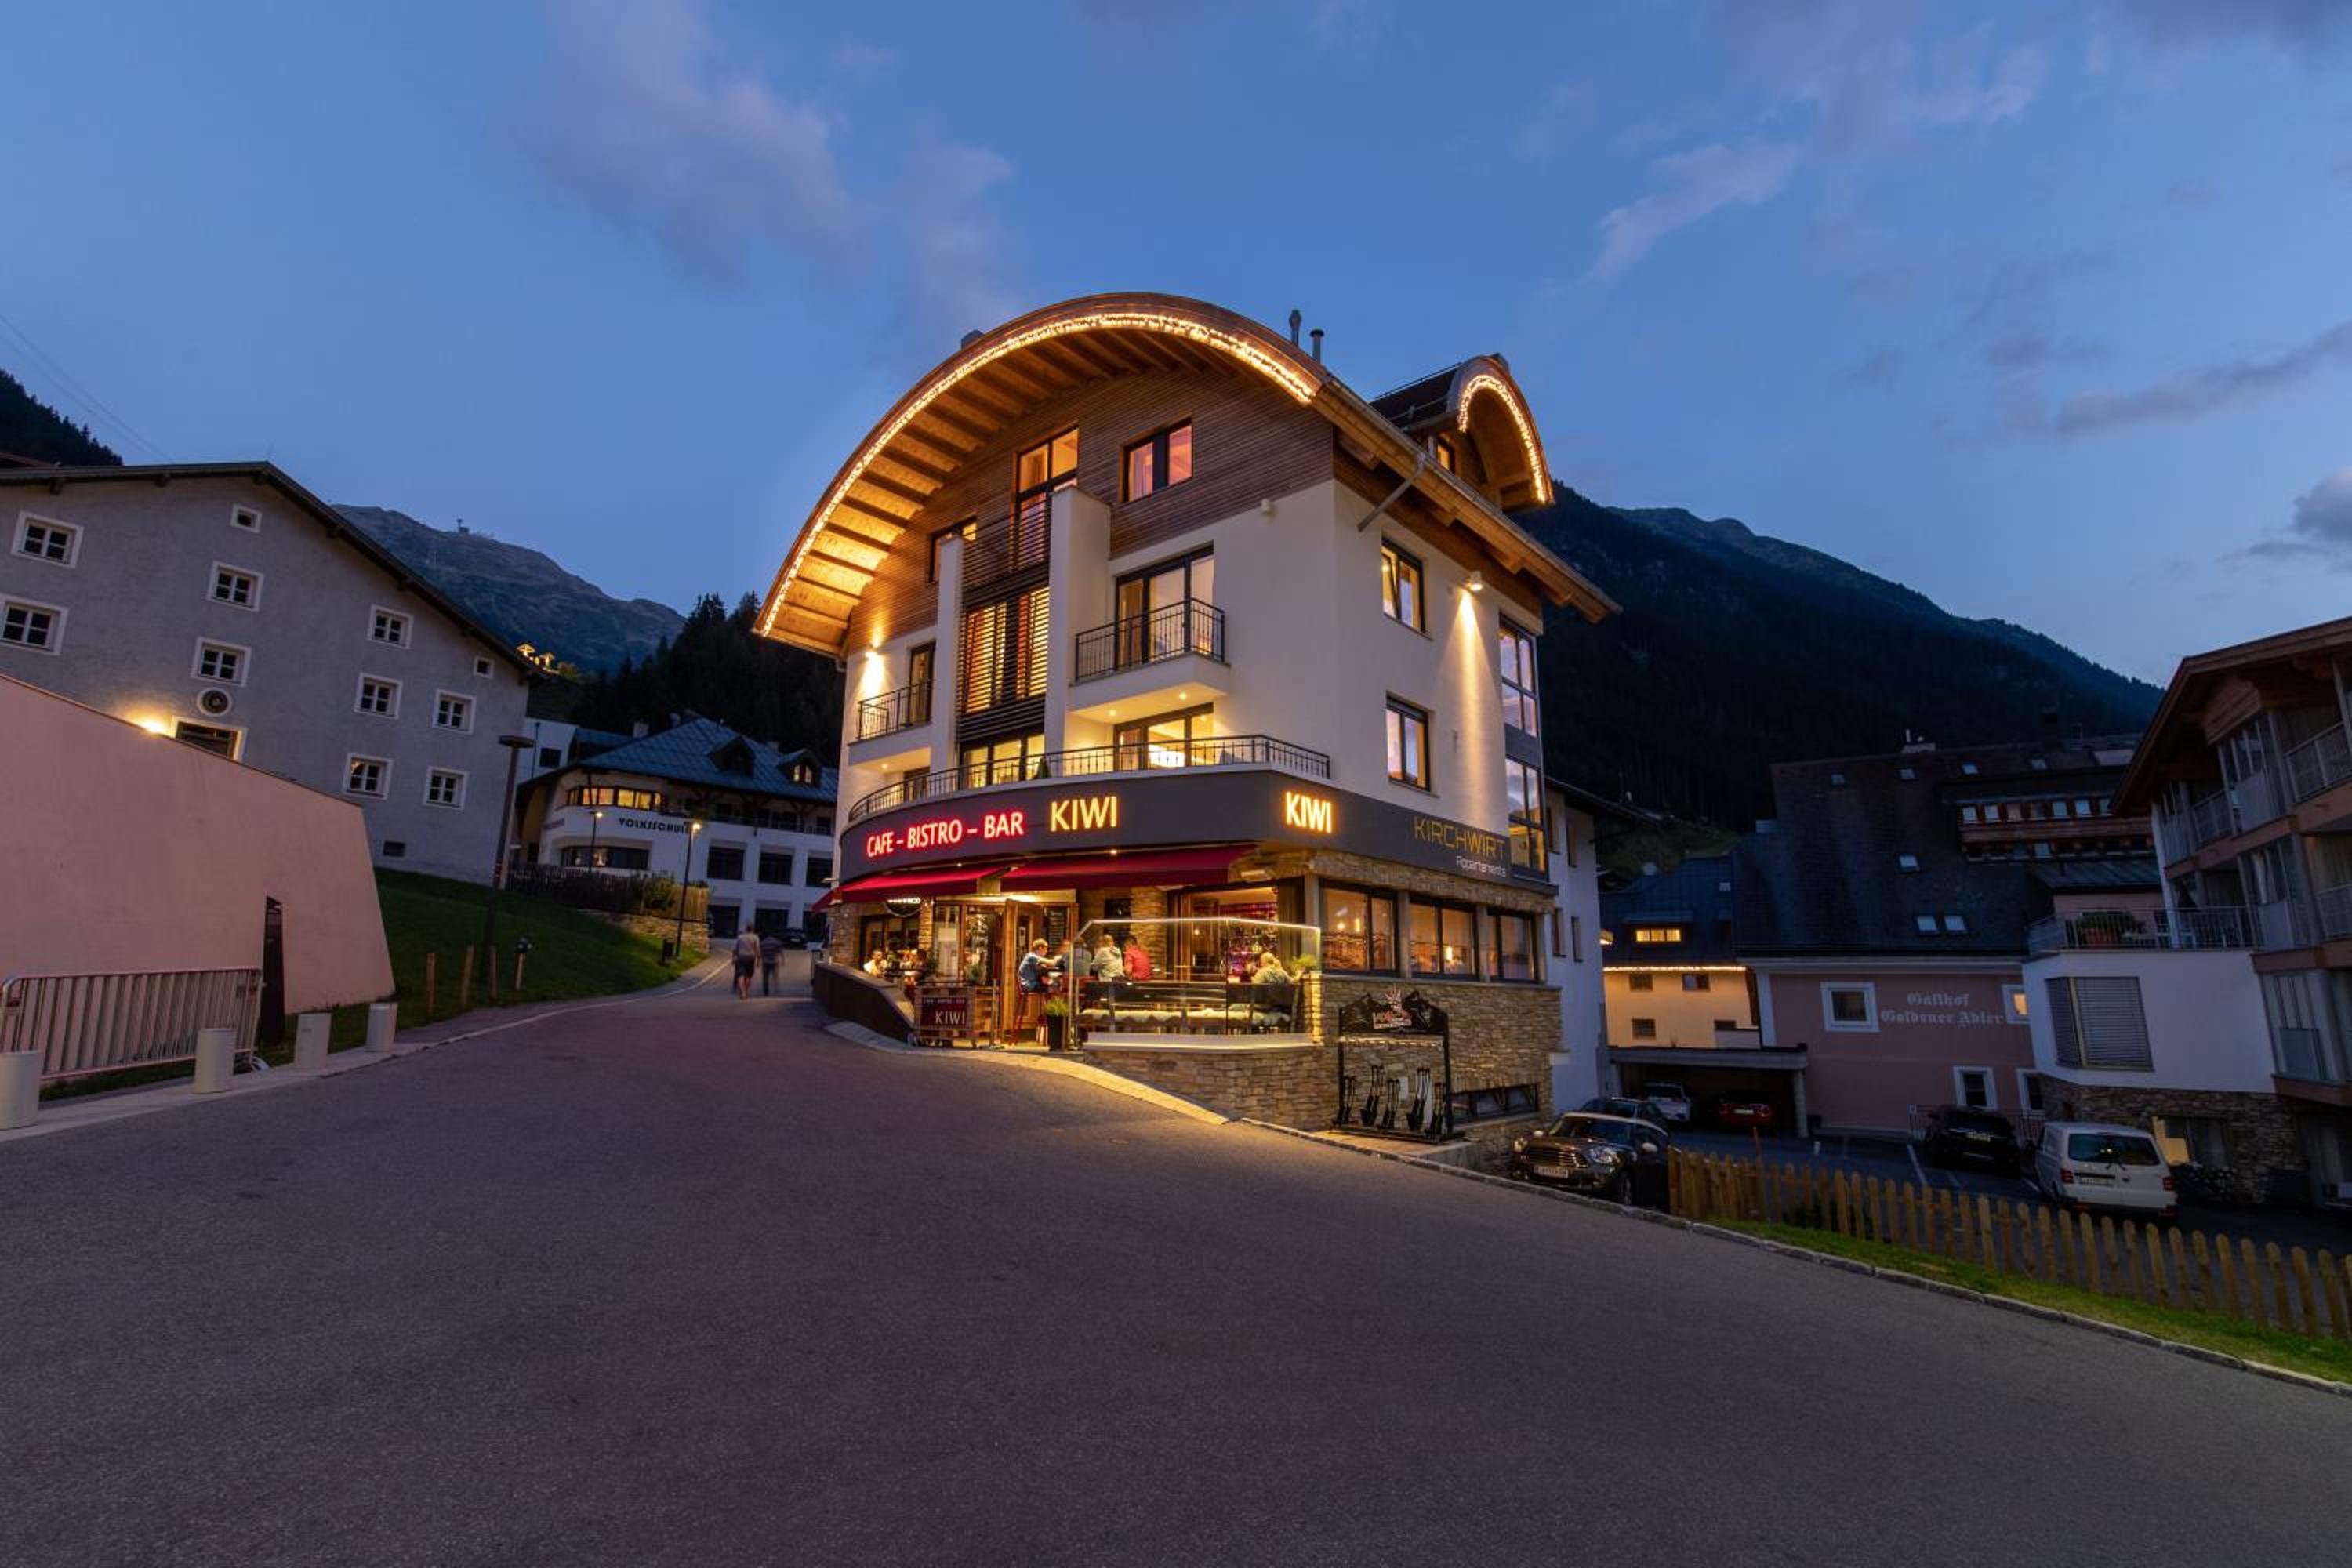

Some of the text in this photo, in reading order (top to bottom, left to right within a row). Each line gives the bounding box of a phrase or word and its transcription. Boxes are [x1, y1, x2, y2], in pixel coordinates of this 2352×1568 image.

[619, 818, 690, 834] VOLKSSCHUL
[1051, 796, 1117, 831] KIWI
[1286, 791, 1332, 833] KIWI
[867, 832, 894, 857] CAFE
[907, 819, 962, 848] BISTRO
[984, 812, 1023, 838] BAR
[1414, 816, 1505, 859] KIRCHWIRT
[935, 1011, 965, 1025] KIWI
